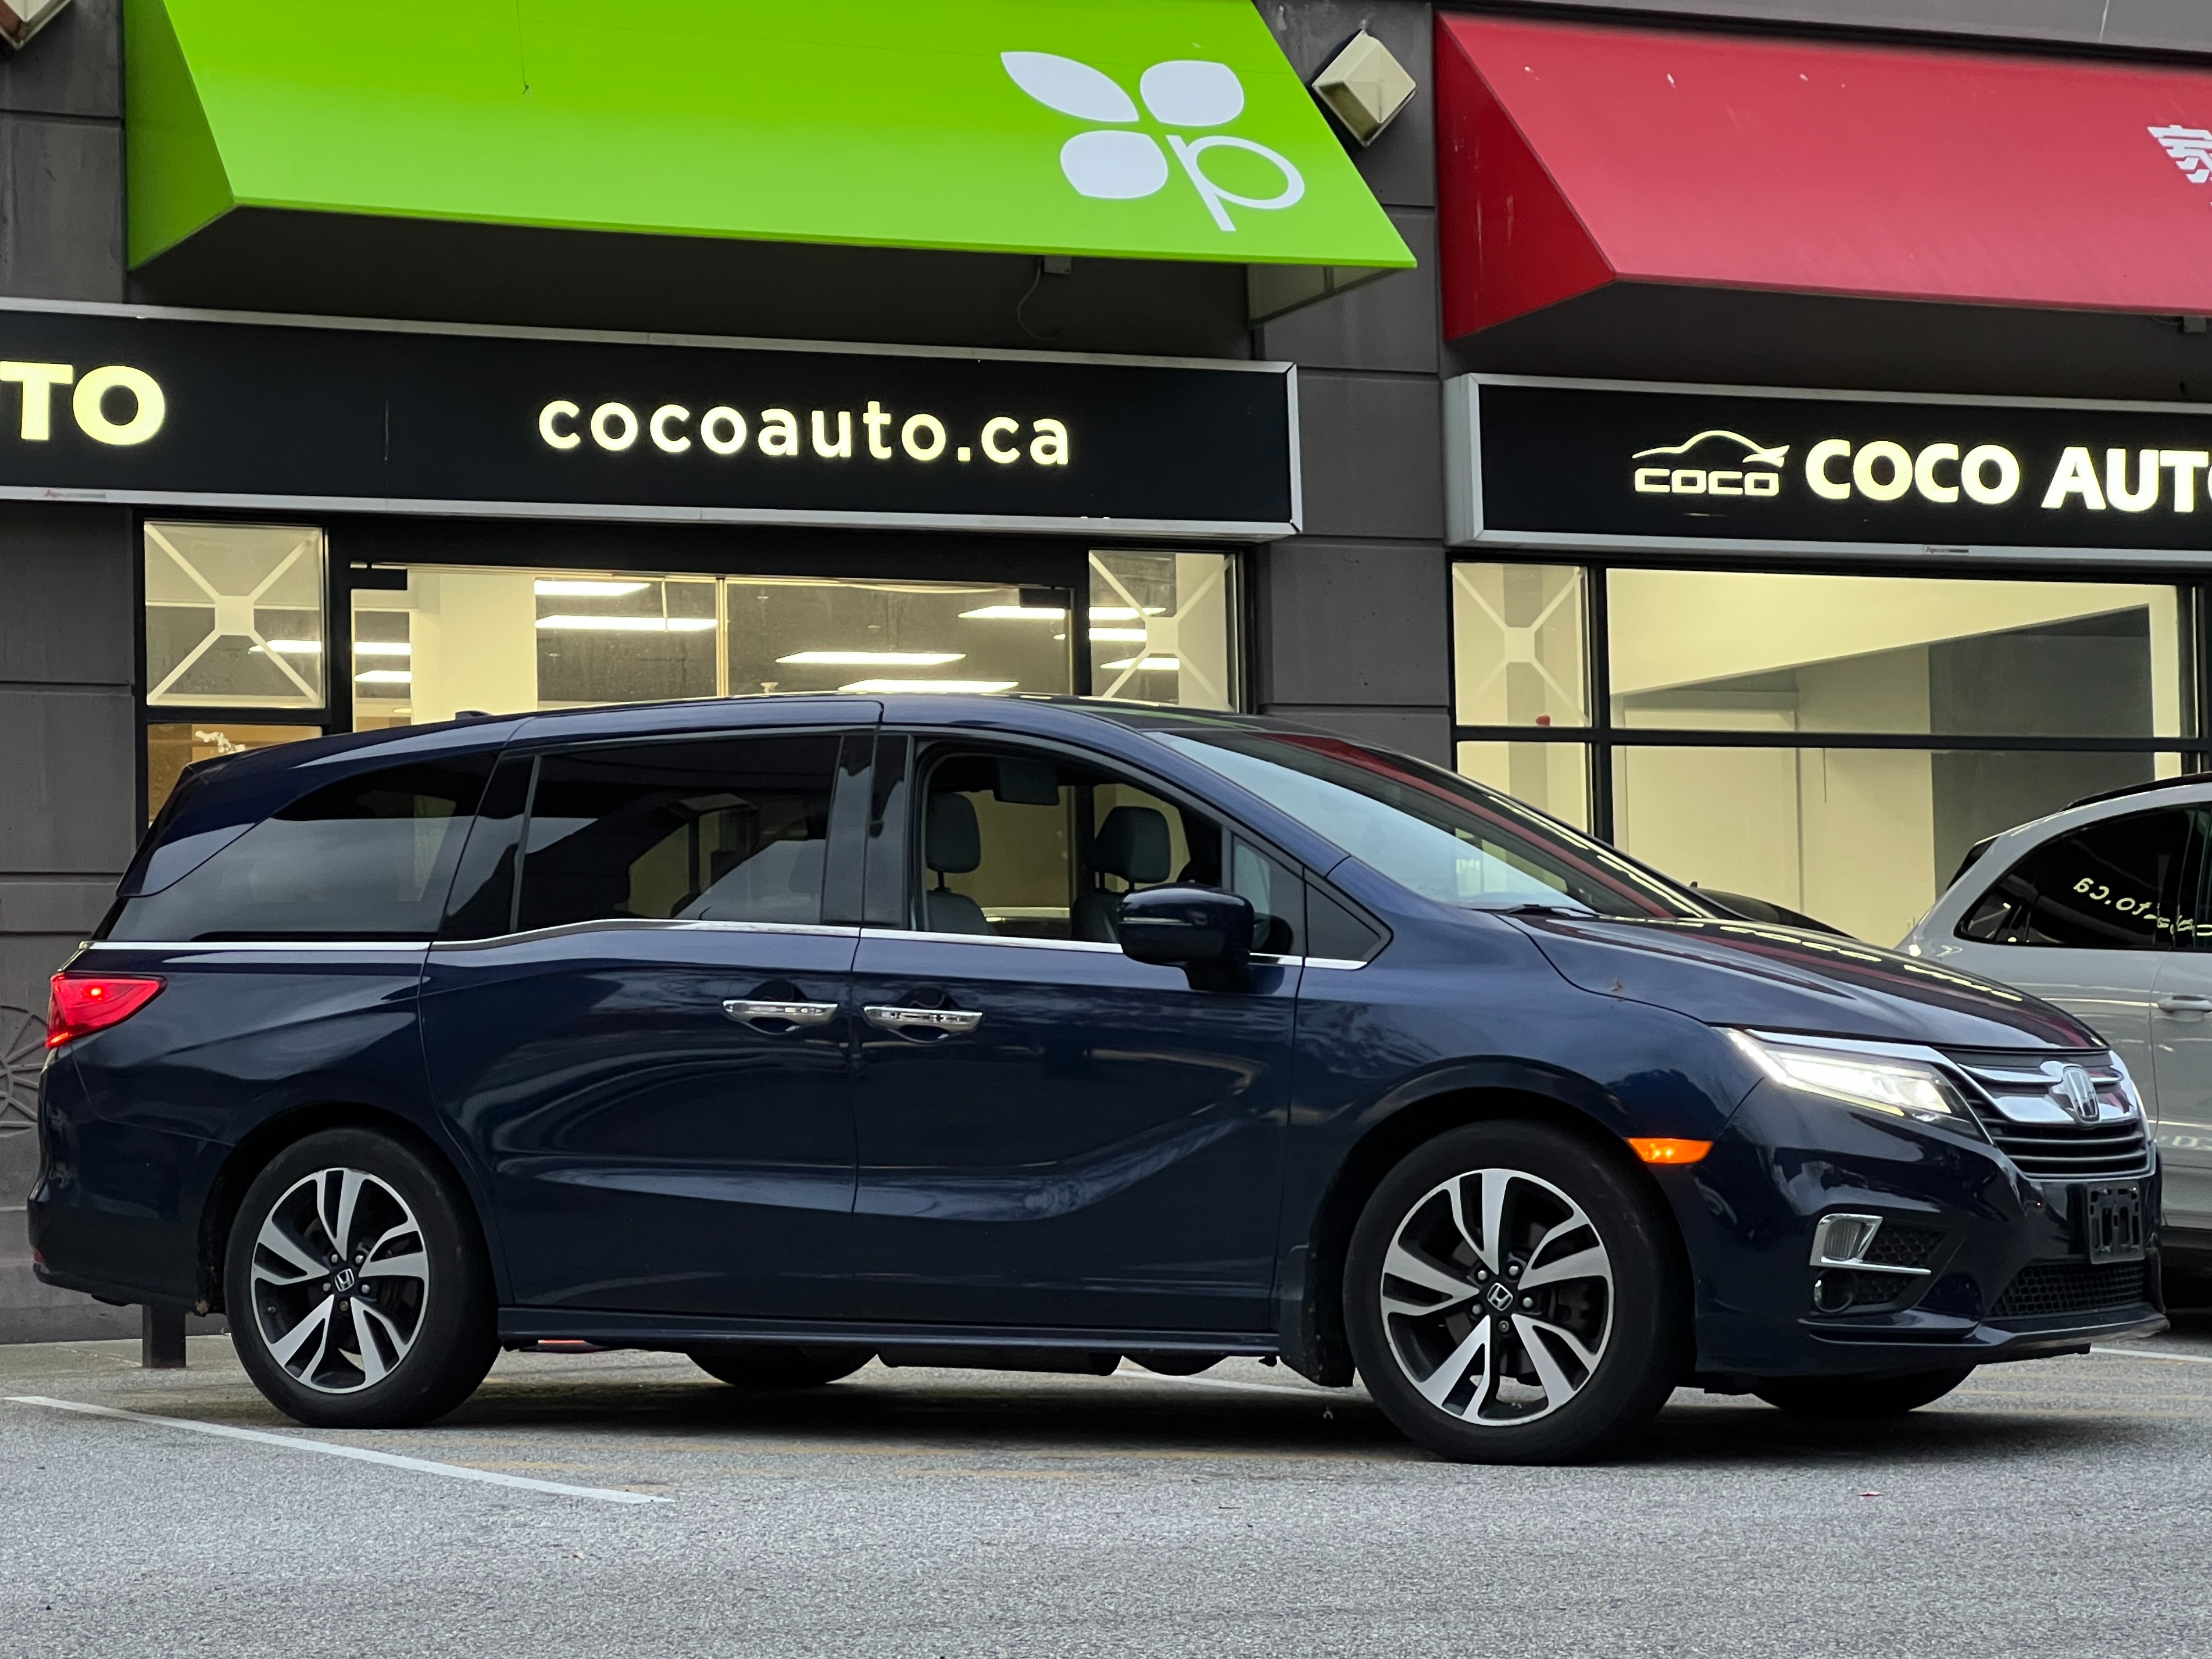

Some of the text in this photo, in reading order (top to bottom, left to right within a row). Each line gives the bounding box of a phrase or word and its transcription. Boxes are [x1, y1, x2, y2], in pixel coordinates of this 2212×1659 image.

[539, 400, 1069, 465] cocoauto.ca
[1635, 467, 1779, 496] COCO
[1805, 439, 2212, 513] COCO AUT
